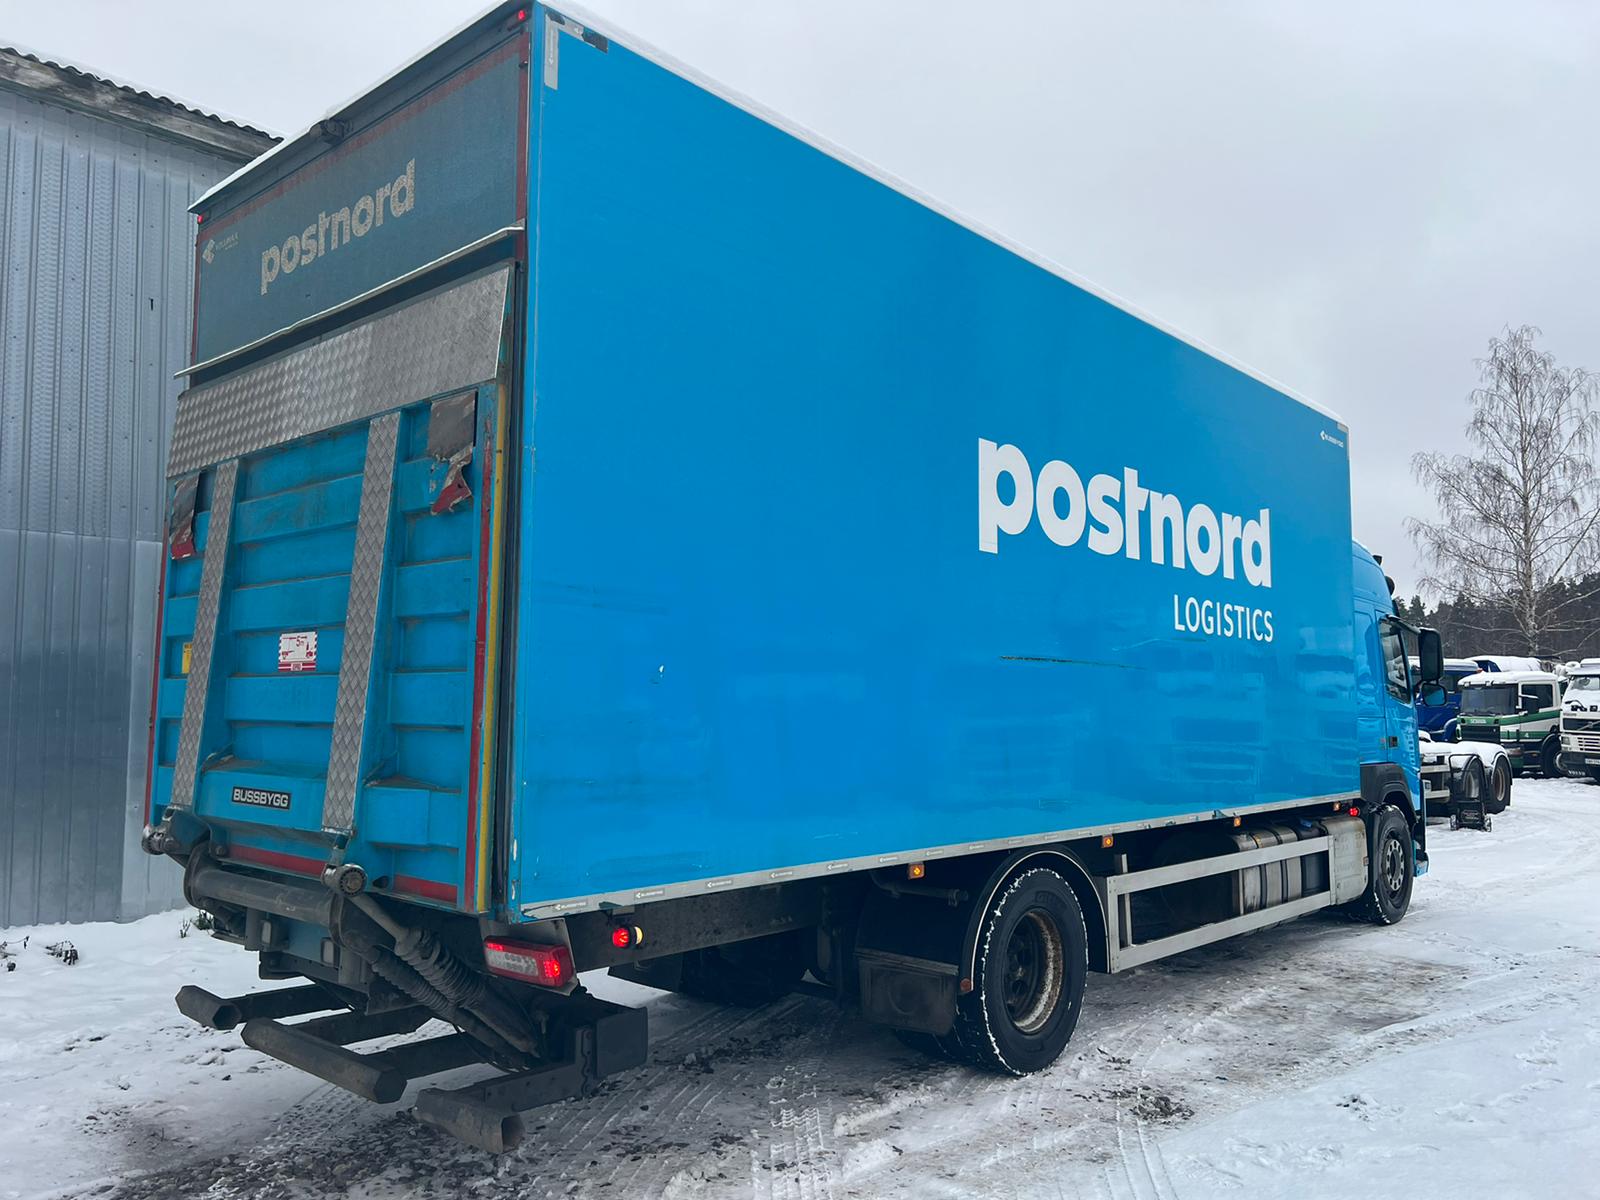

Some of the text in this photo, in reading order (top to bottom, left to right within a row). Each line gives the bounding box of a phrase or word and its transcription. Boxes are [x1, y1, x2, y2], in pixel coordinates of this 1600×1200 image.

[260, 158, 415, 296] postnord
[978, 437, 1272, 588] postnord
[1174, 594, 1274, 643] LOGISTICS
[233, 788, 289, 807] BUSSBYGG
